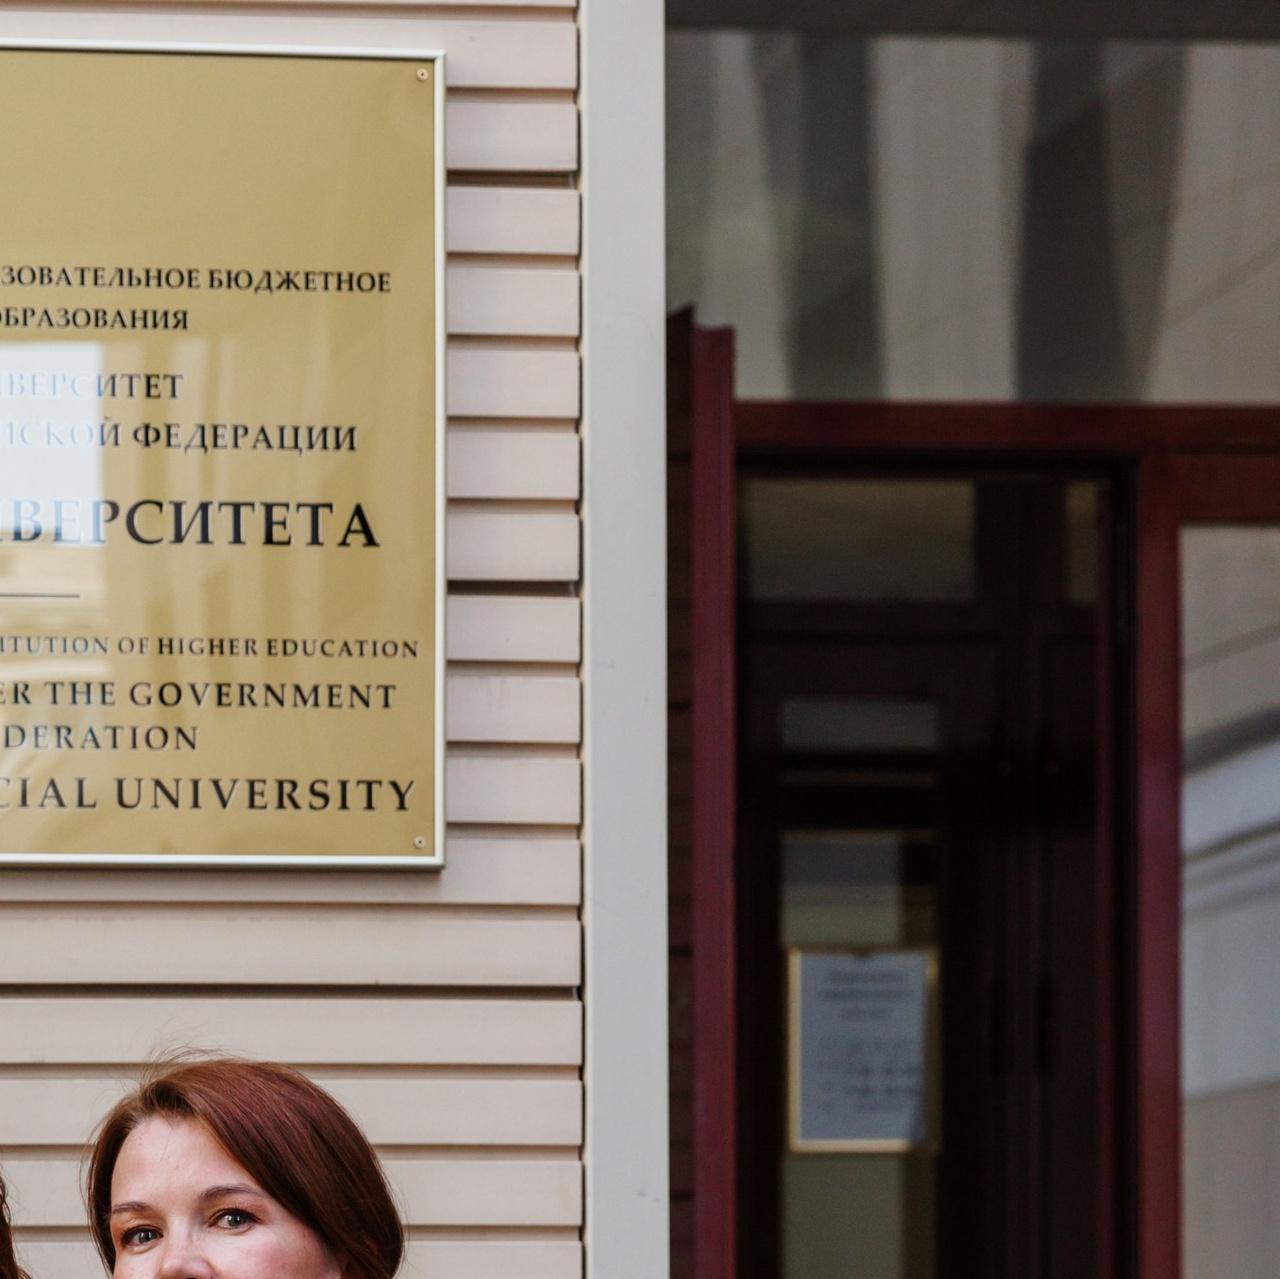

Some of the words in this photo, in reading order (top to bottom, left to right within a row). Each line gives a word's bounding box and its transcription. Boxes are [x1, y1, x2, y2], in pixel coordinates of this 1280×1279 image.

[208, 269, 392, 295] БЮДЖЕТНОЕ
[132, 422, 359, 454] ФЕДЕРАЦИИ
[118, 637, 150, 655] OF
[158, 637, 258, 657] HIGHER
[267, 638, 420, 659] EDUCATION
[44, 682, 117, 706] THE
[129, 682, 397, 709] GOVERNMENT
[116, 777, 415, 812] UNIVERSITY
